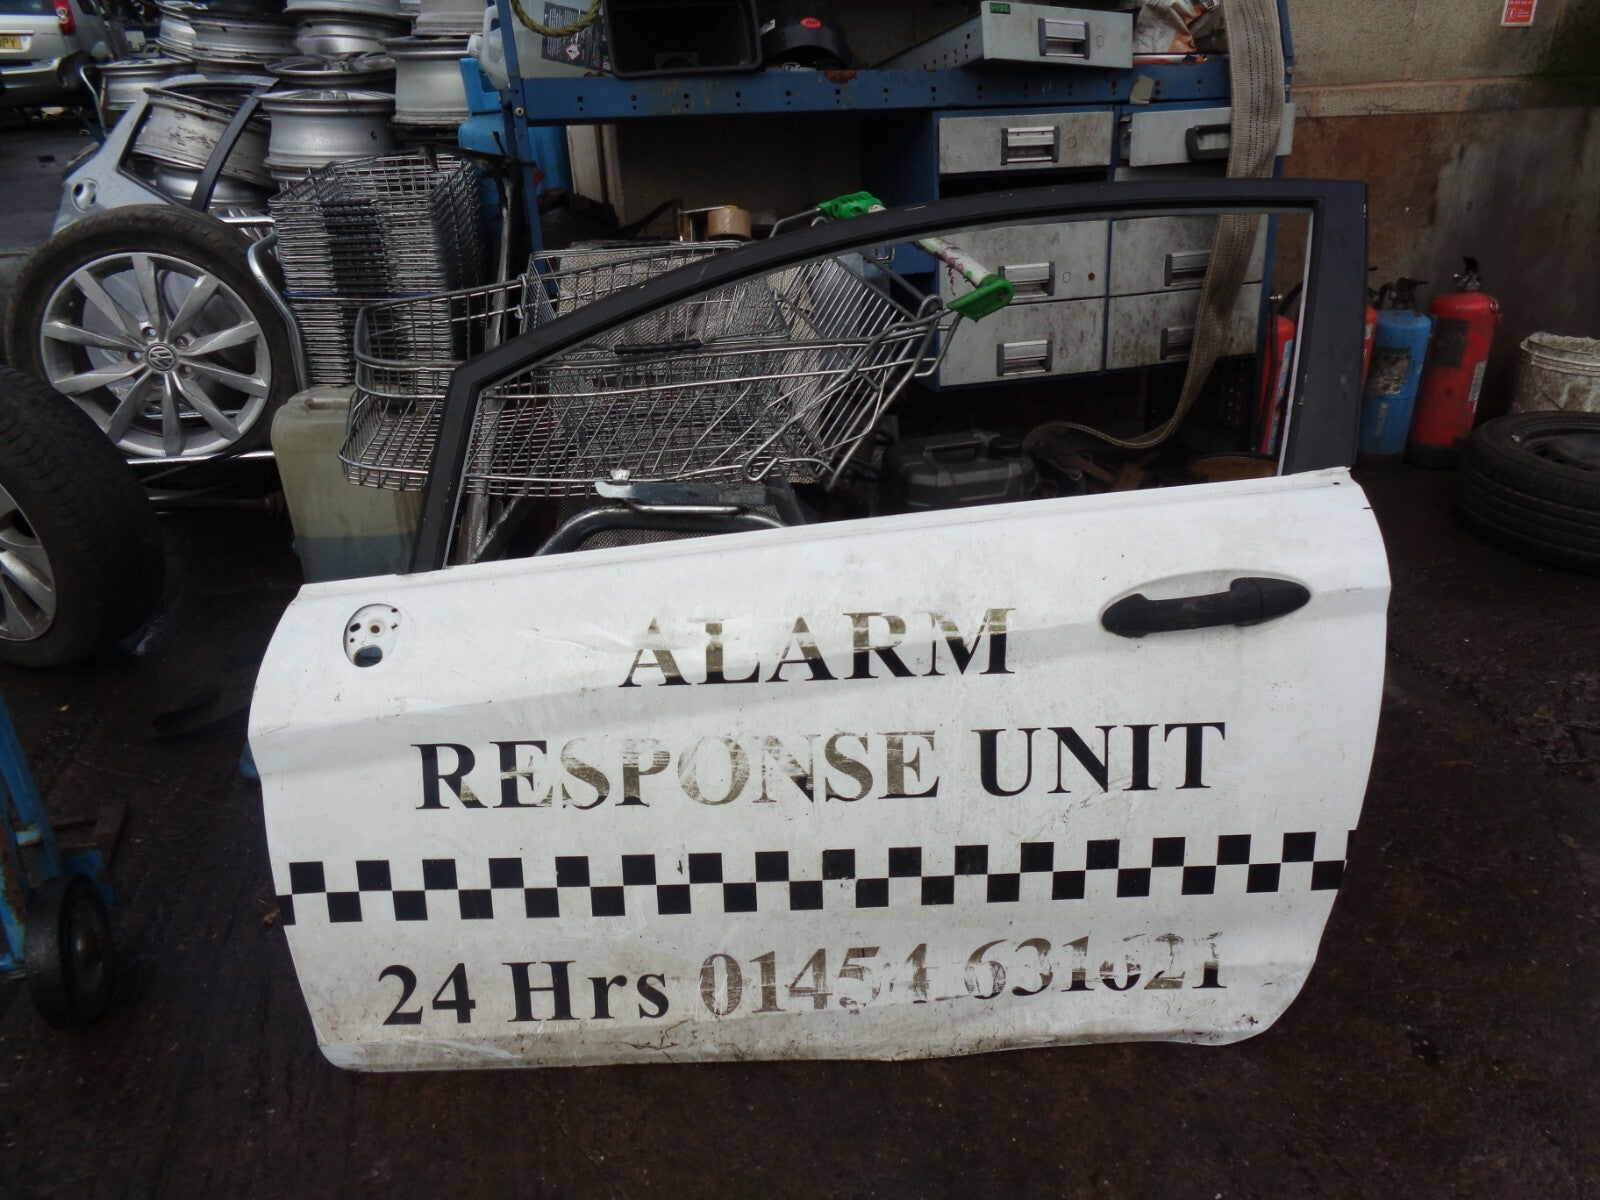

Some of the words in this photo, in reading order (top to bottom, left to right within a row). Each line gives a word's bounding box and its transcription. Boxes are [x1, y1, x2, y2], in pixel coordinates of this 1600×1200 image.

[618, 607, 1016, 688] ALARM
[410, 730, 940, 811] RESPONSE
[971, 721, 1226, 797] UNIT
[378, 962, 477, 1026] 24
[501, 960, 670, 1023] Hrs
